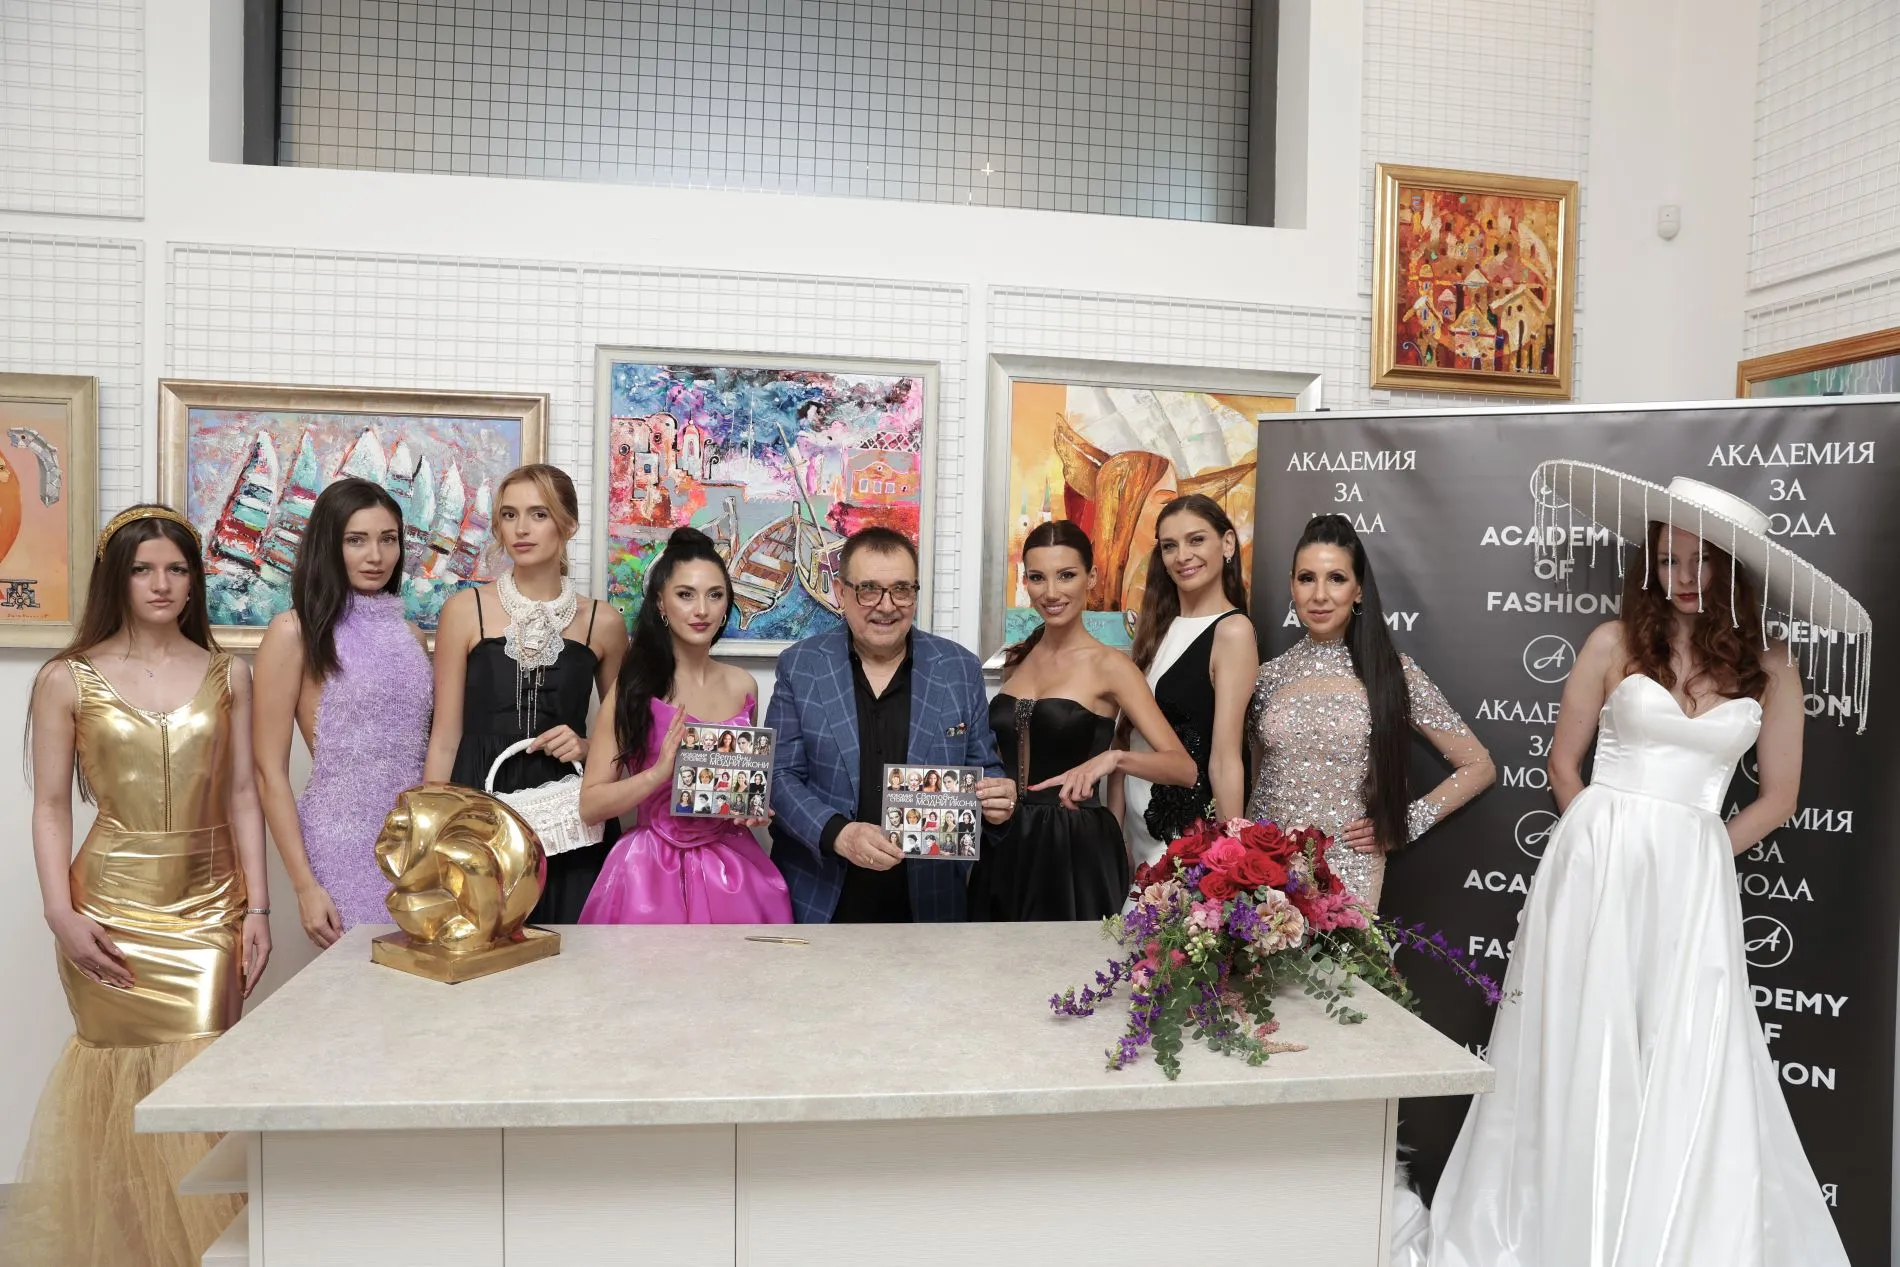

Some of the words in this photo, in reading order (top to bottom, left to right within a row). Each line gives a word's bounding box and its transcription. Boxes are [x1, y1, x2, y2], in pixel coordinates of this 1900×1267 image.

[1286, 450, 1417, 473] АКАДЕМИЯ
[1706, 441, 1876, 468] АКАДЕМИЯ
[1334, 482, 1364, 502] ЗА
[1769, 478, 1807, 501] ЗА
[1311, 512, 1387, 534] ДА
[1767, 512, 1837, 538] ОДА
[1534, 558, 1576, 580] OF
[1487, 591, 1621, 615] FASHION
[1475, 698, 1561, 726] АКАДЕ
[742, 761, 769, 769] ИКОНИ
[1502, 765, 1553, 792] МО
[915, 799, 947, 807] МОДНИ
[1747, 840, 1785, 864] ЗА
[1750, 984, 1849, 1017] DEMY
[1763, 1022, 1783, 1044] F
